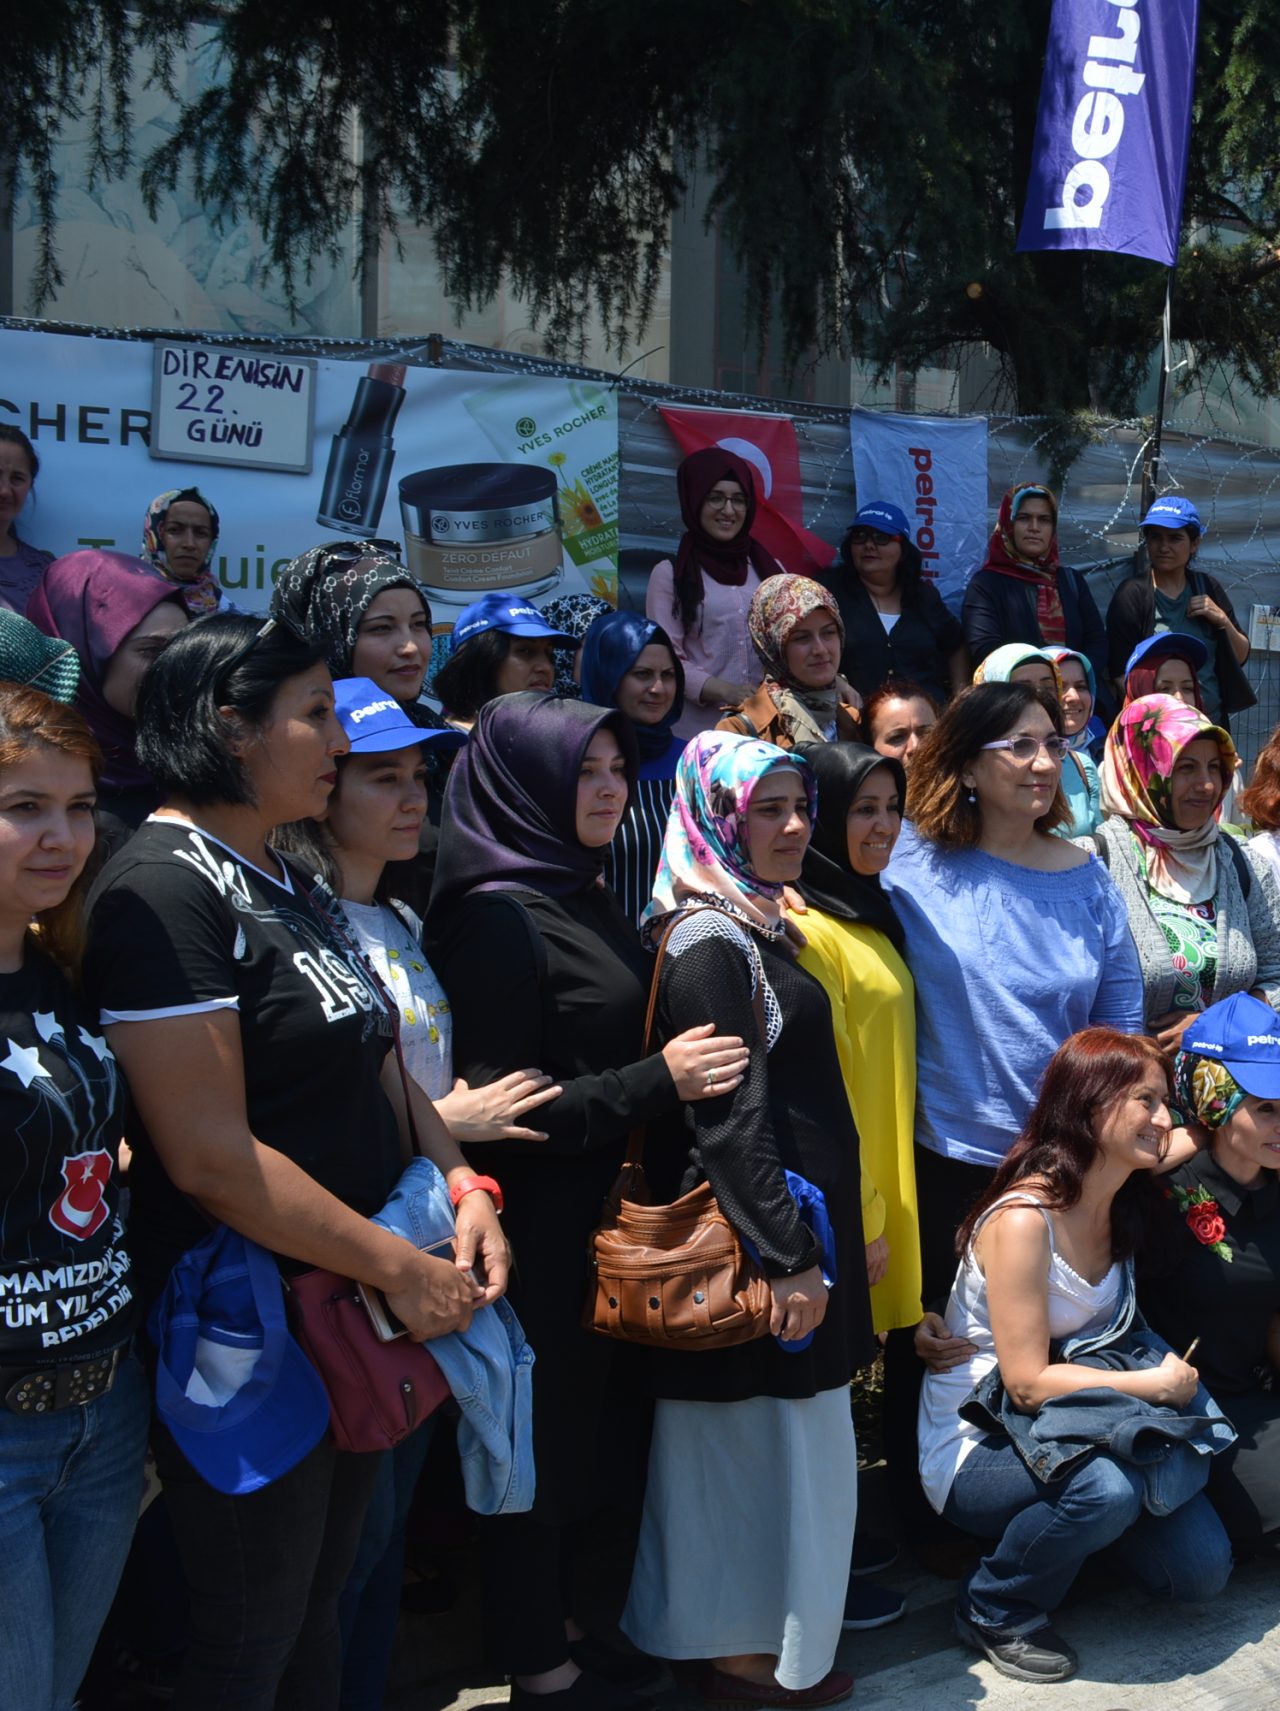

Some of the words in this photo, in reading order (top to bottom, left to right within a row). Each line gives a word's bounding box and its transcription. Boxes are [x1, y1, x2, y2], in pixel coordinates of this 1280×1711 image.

[187, 418, 263, 448] GÜNÜ
[517, 432, 552, 456] YVES
[553, 404, 607, 439] ROCHER
[454, 520, 489, 531] YVES
[494, 512, 544, 530] ROCHER
[908, 447, 940, 586] petrol-i
[442, 552, 478, 564] ZÉRO
[481, 547, 532, 563] DÉFAUT
